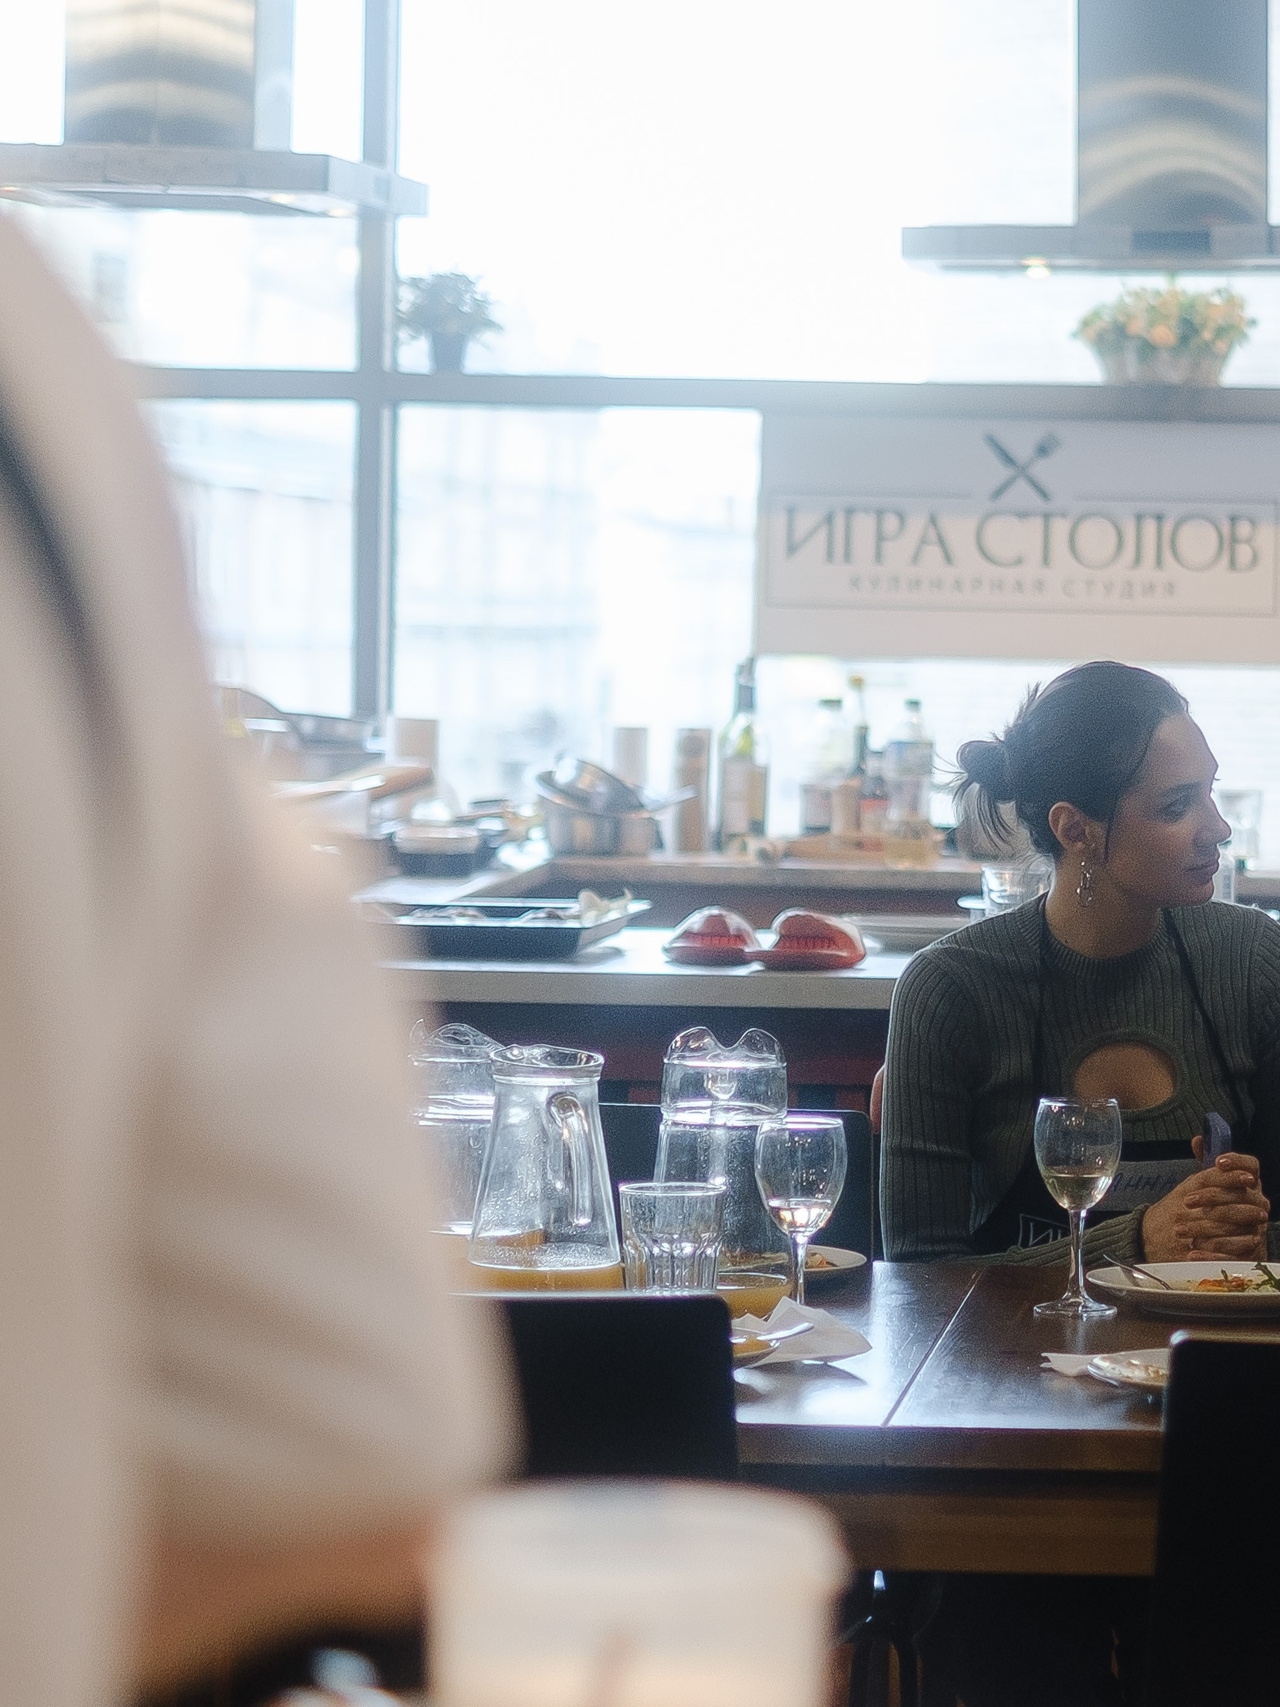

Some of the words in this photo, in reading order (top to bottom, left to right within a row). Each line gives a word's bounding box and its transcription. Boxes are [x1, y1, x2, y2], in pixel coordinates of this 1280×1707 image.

[785, 504, 956, 566] ИГРА
[974, 509, 1259, 571] СТОЛОВ
[850, 573, 1047, 594] КУЛИНАРНАЯ
[1062, 578, 1175, 600] СТУДИЯ
